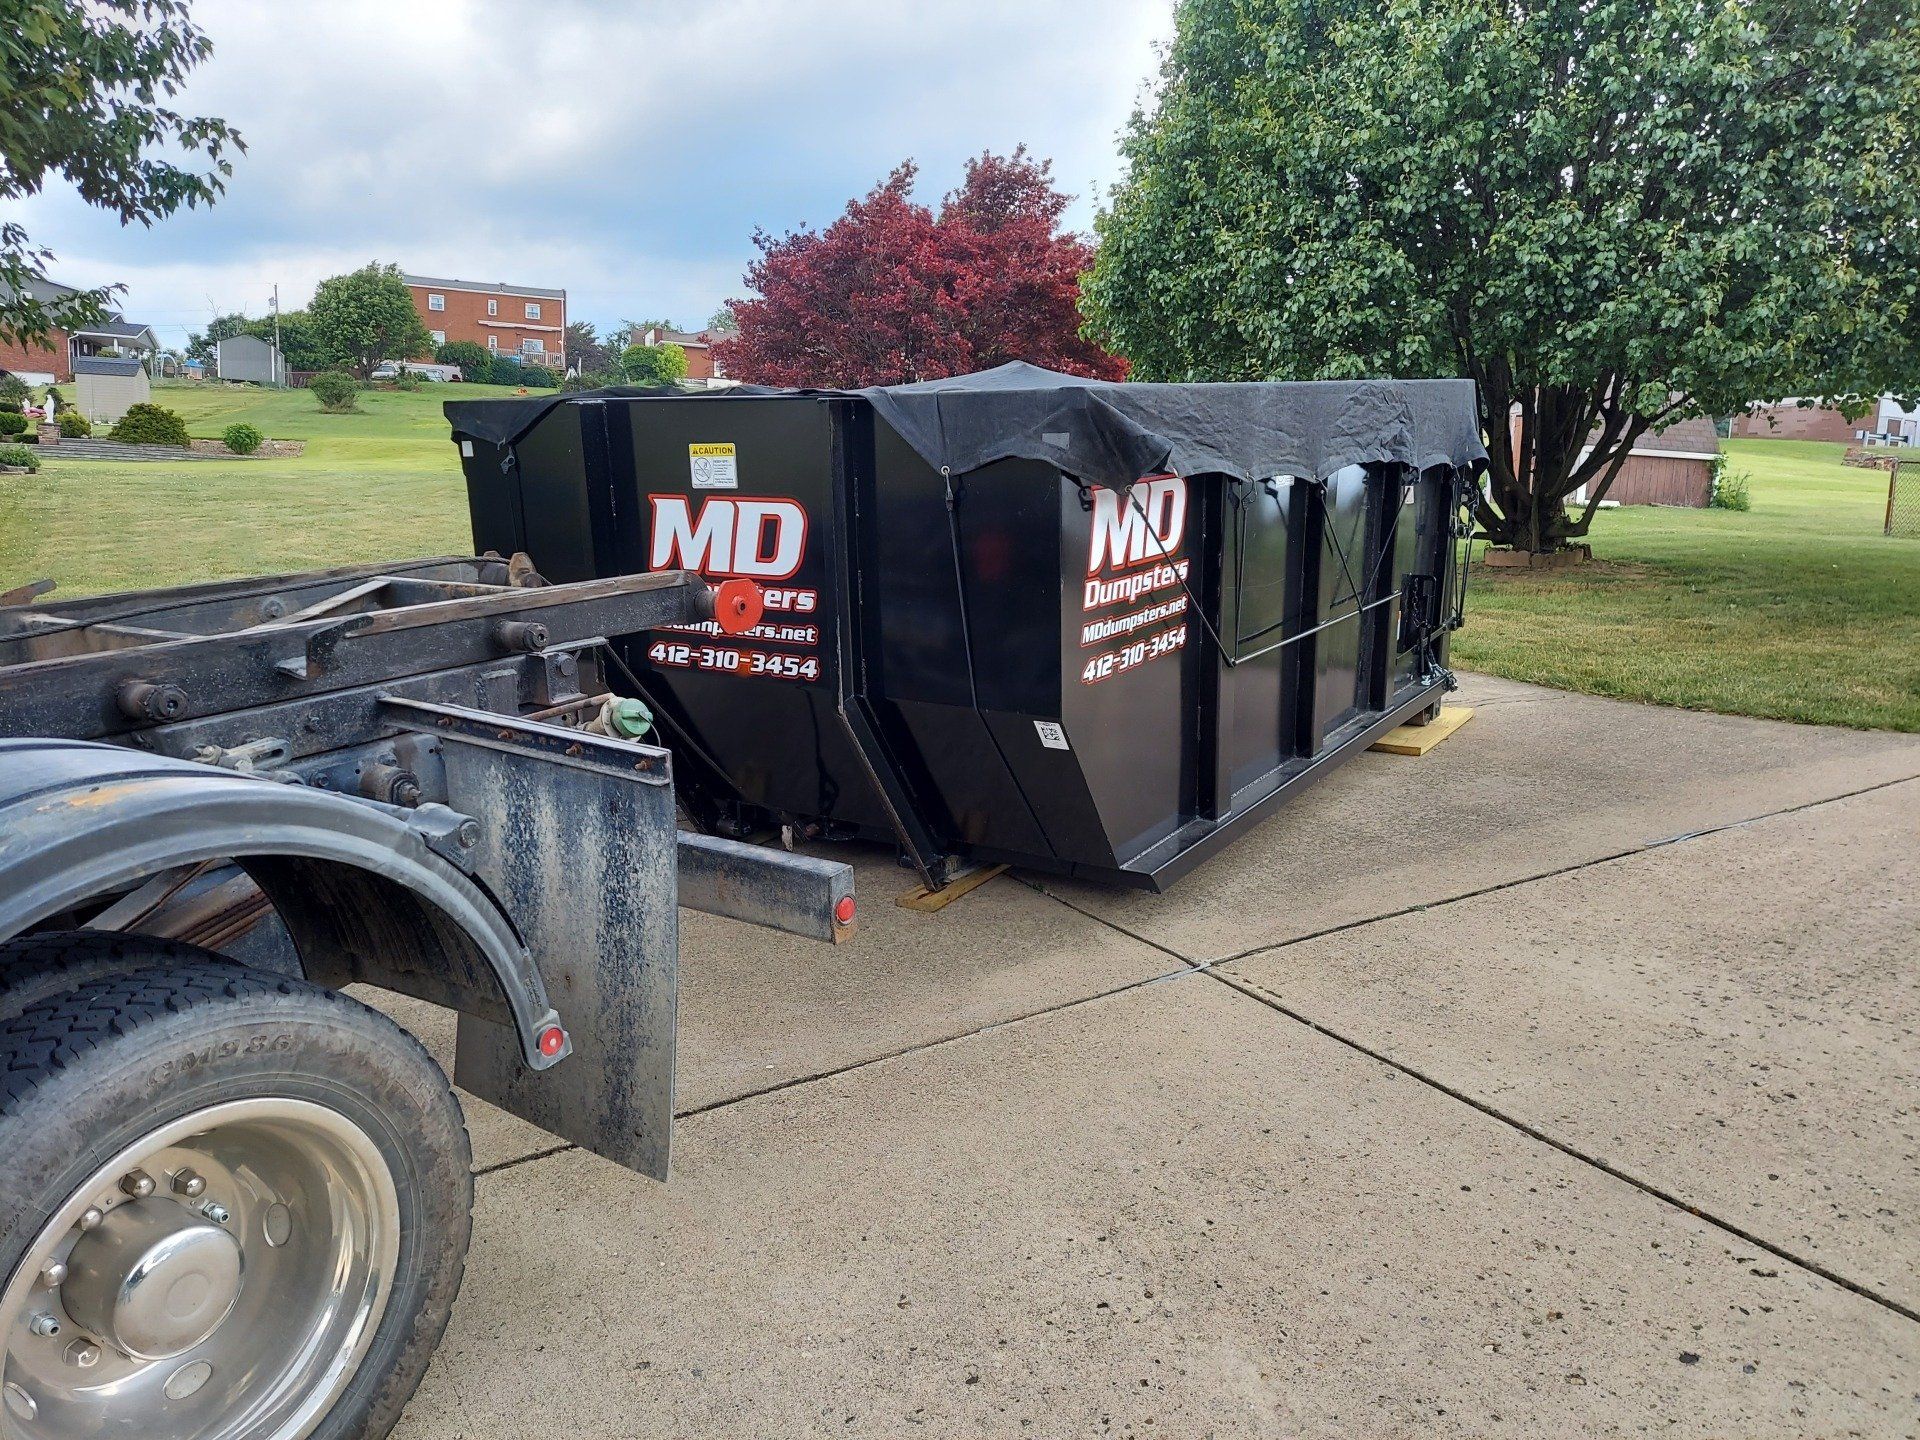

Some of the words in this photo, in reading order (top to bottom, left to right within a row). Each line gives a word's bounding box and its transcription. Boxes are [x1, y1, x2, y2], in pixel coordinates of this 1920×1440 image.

[698, 446, 733, 455] CAUTION
[649, 495, 808, 579] MD
[1088, 475, 1187, 576] MD
[1084, 560, 1189, 610] Dumpsters
[1081, 596, 1188, 645] MDdumpsters.net
[649, 642, 818, 679] 412-310-3454
[1082, 626, 1186, 683] 412-310-3454
